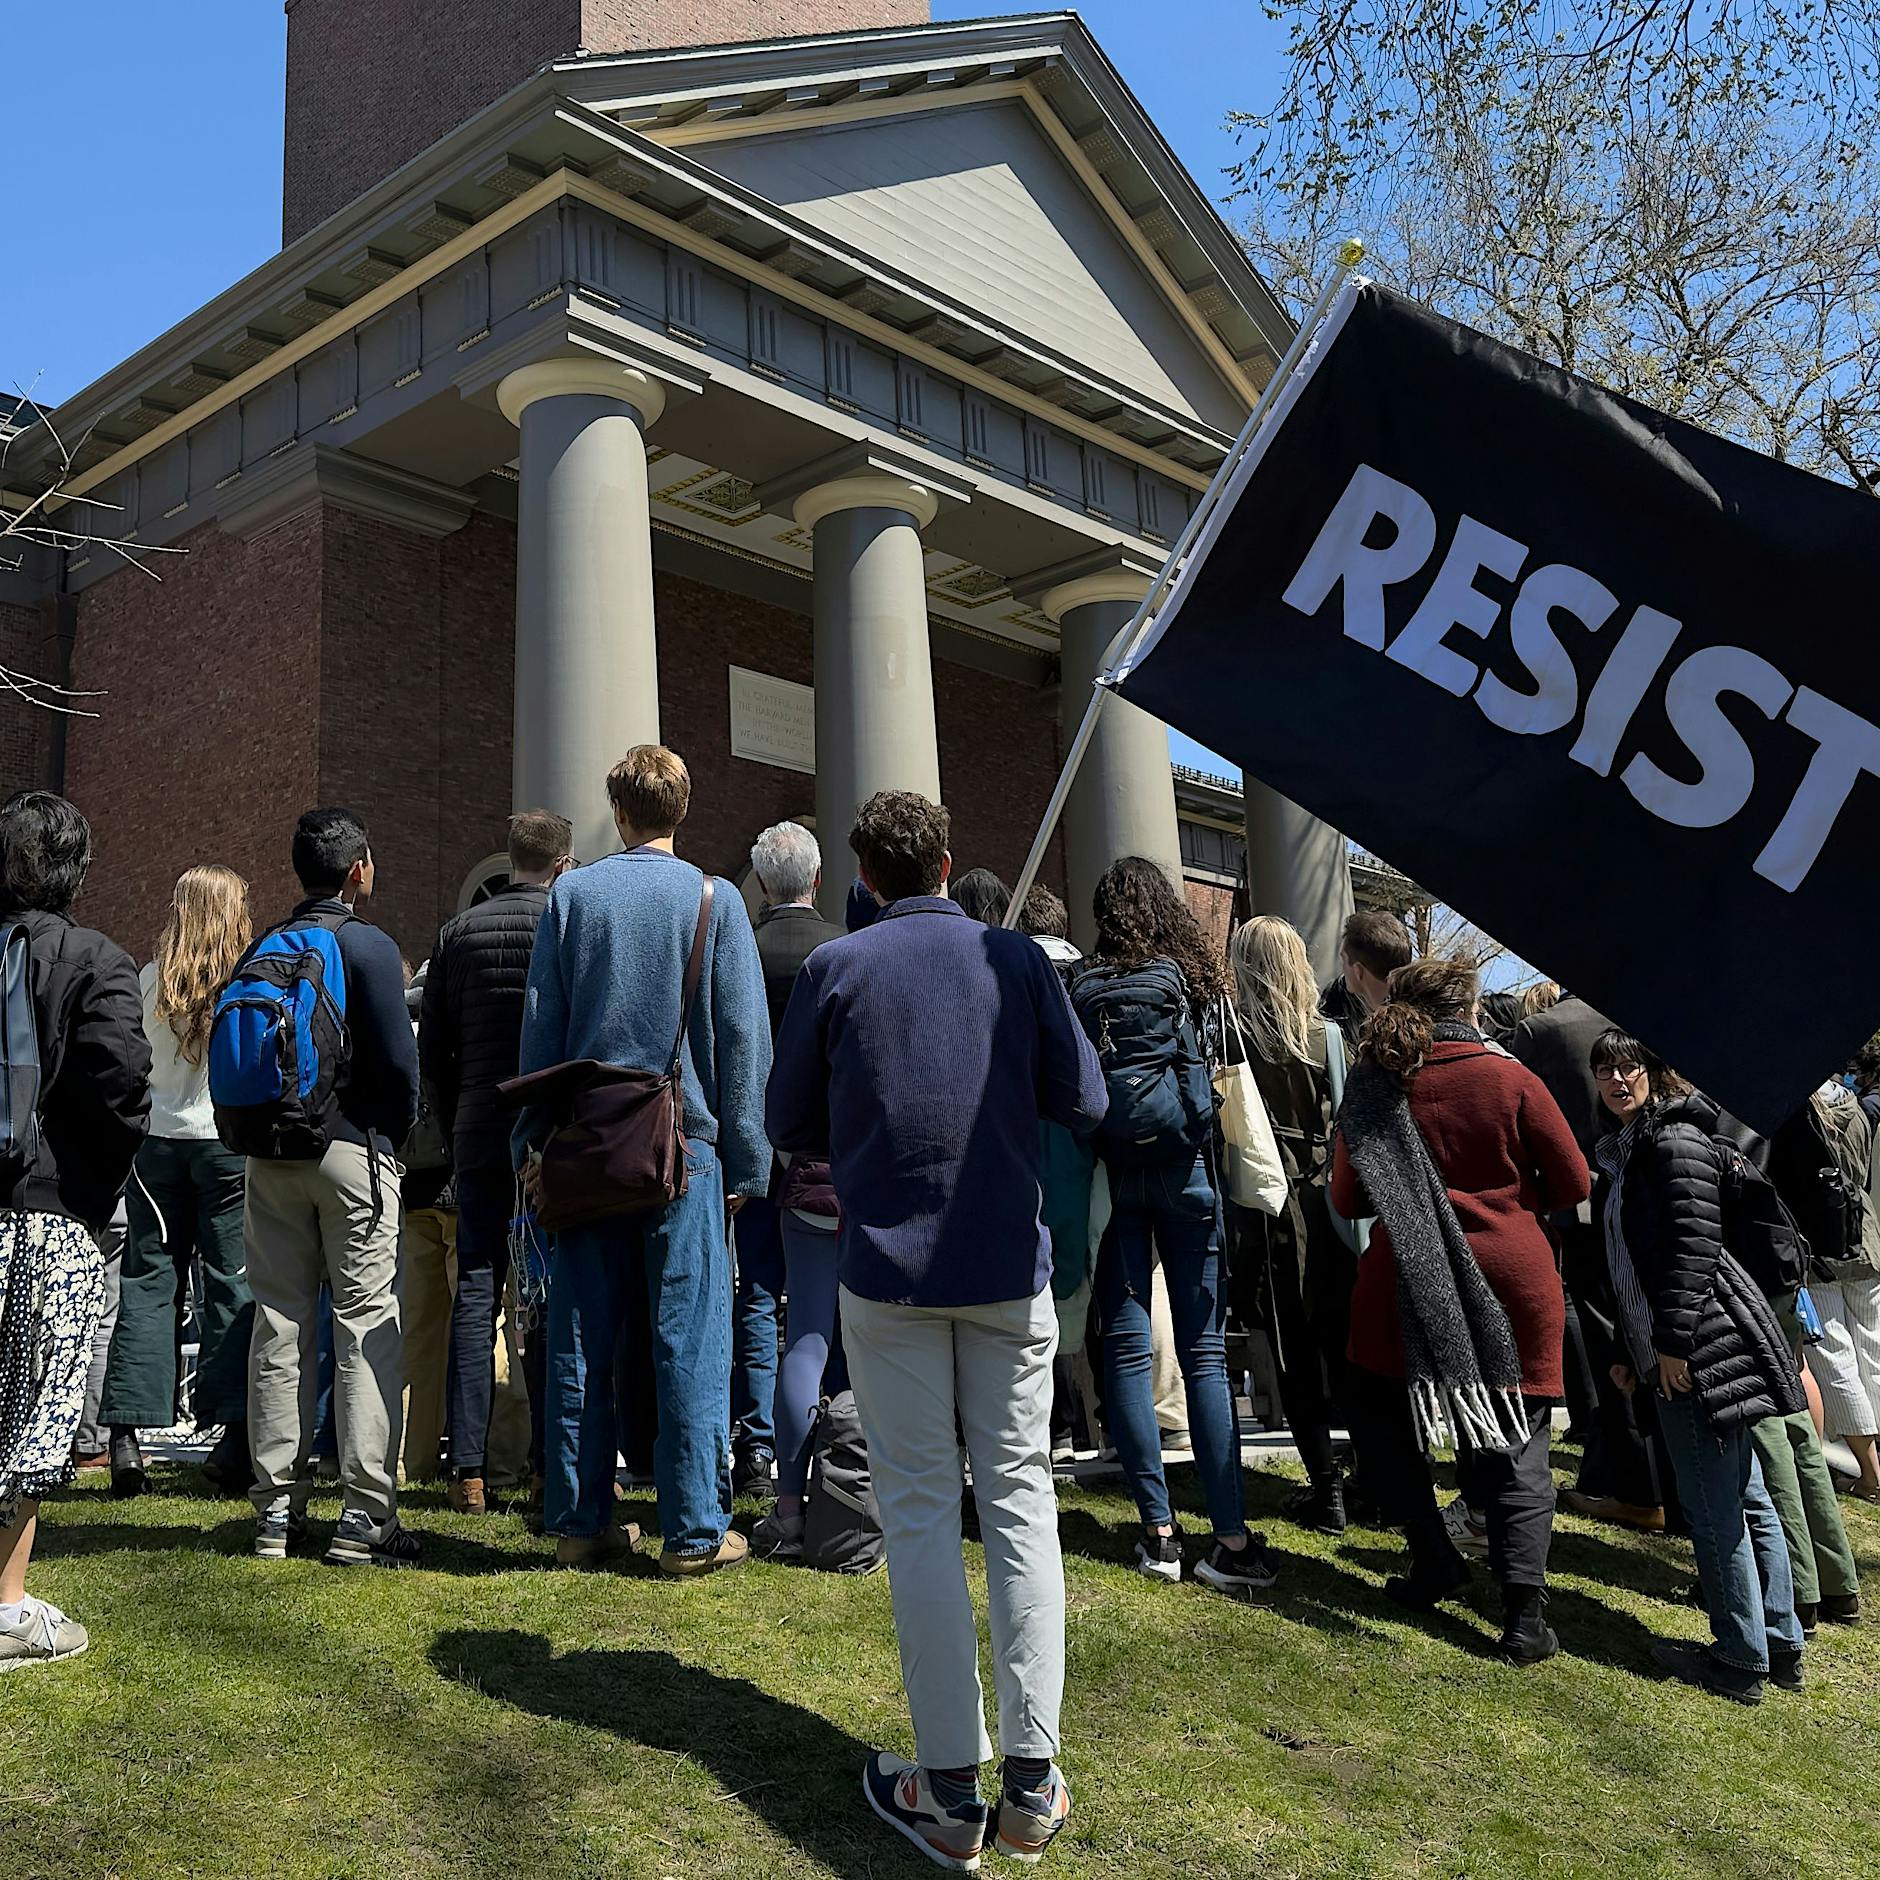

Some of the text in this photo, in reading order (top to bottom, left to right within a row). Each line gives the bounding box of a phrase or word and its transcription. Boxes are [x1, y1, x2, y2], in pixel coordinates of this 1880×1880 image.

[1282, 462, 1880, 893] RESIST
[737, 701, 753, 713] THE
[756, 705, 791, 722] HARVARD
[739, 727, 752, 738] WE
[754, 733, 774, 746] HAVE
